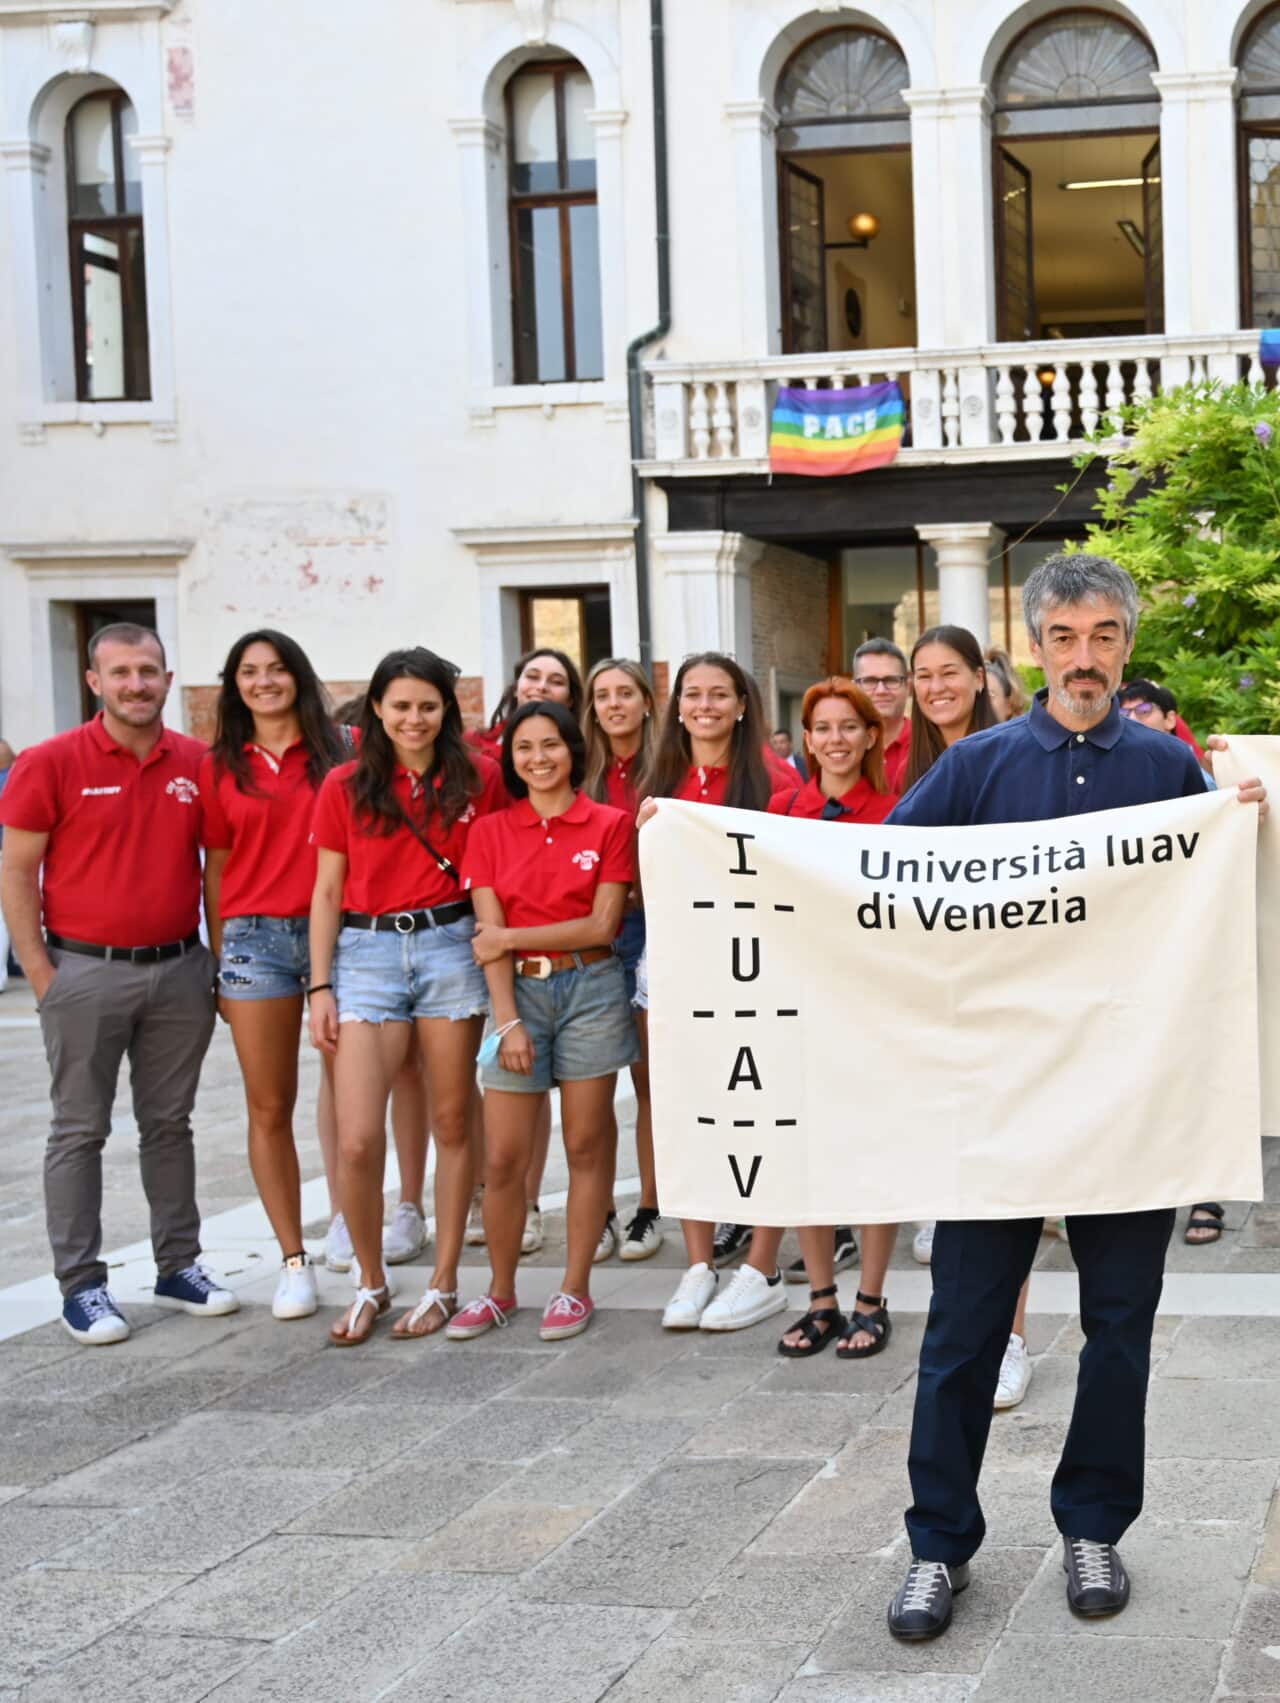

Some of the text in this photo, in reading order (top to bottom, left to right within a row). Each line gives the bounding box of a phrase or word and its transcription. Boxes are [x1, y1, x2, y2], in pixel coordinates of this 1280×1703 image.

[803, 409, 877, 438] PACE
[860, 832, 1200, 883] Università Iuav
[857, 886, 1087, 932] di Venezia
